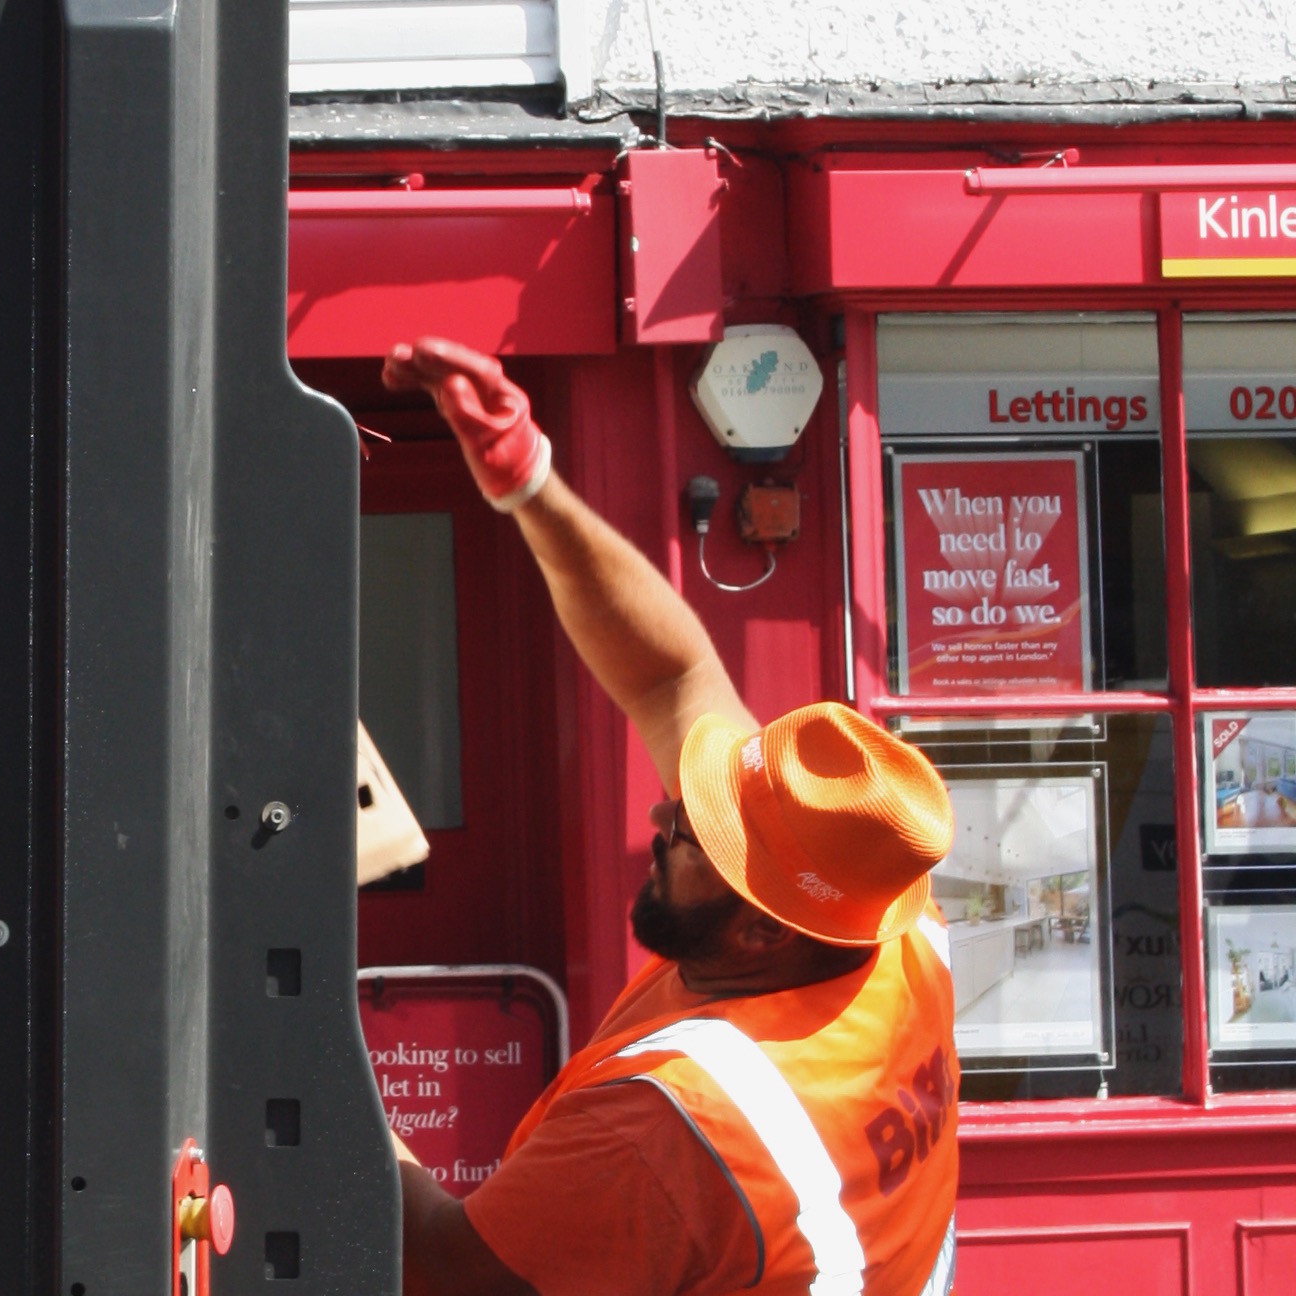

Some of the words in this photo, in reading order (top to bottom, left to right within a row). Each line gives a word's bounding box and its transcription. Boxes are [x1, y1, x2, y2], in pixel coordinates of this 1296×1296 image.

[1198, 193, 1296, 239] Kinle
[713, 362, 809, 374] OAKND
[988, 386, 1148, 431] Lettings
[1229, 385, 1296, 421] 020
[917, 488, 1004, 516] When
[1011, 496, 1061, 522] you
[940, 524, 1006, 553] need
[1014, 527, 1042, 551] to
[923, 568, 997, 589] move
[1005, 559, 1060, 590] fast,
[932, 606, 963, 626] so
[971, 597, 1006, 625] do
[1014, 604, 1061, 624] we.
[931, 643, 946, 652] We
[964, 642, 993, 651] homes
[995, 641, 1019, 650] faster
[1021, 641, 1040, 650] than
[1042, 642, 1058, 652] any
[936, 653, 960, 663] other
[962, 654, 976, 664] top
[979, 654, 1004, 664] agent
[1005, 652, 1014, 661] in
[1214, 721, 1239, 748] SOLD
[797, 872, 844, 901] APEROL
[369, 1042, 449, 1072] ooking
[454, 1047, 478, 1065] to
[484, 1041, 522, 1065] sell
[382, 1074, 410, 1097] let
[417, 1074, 441, 1097] in
